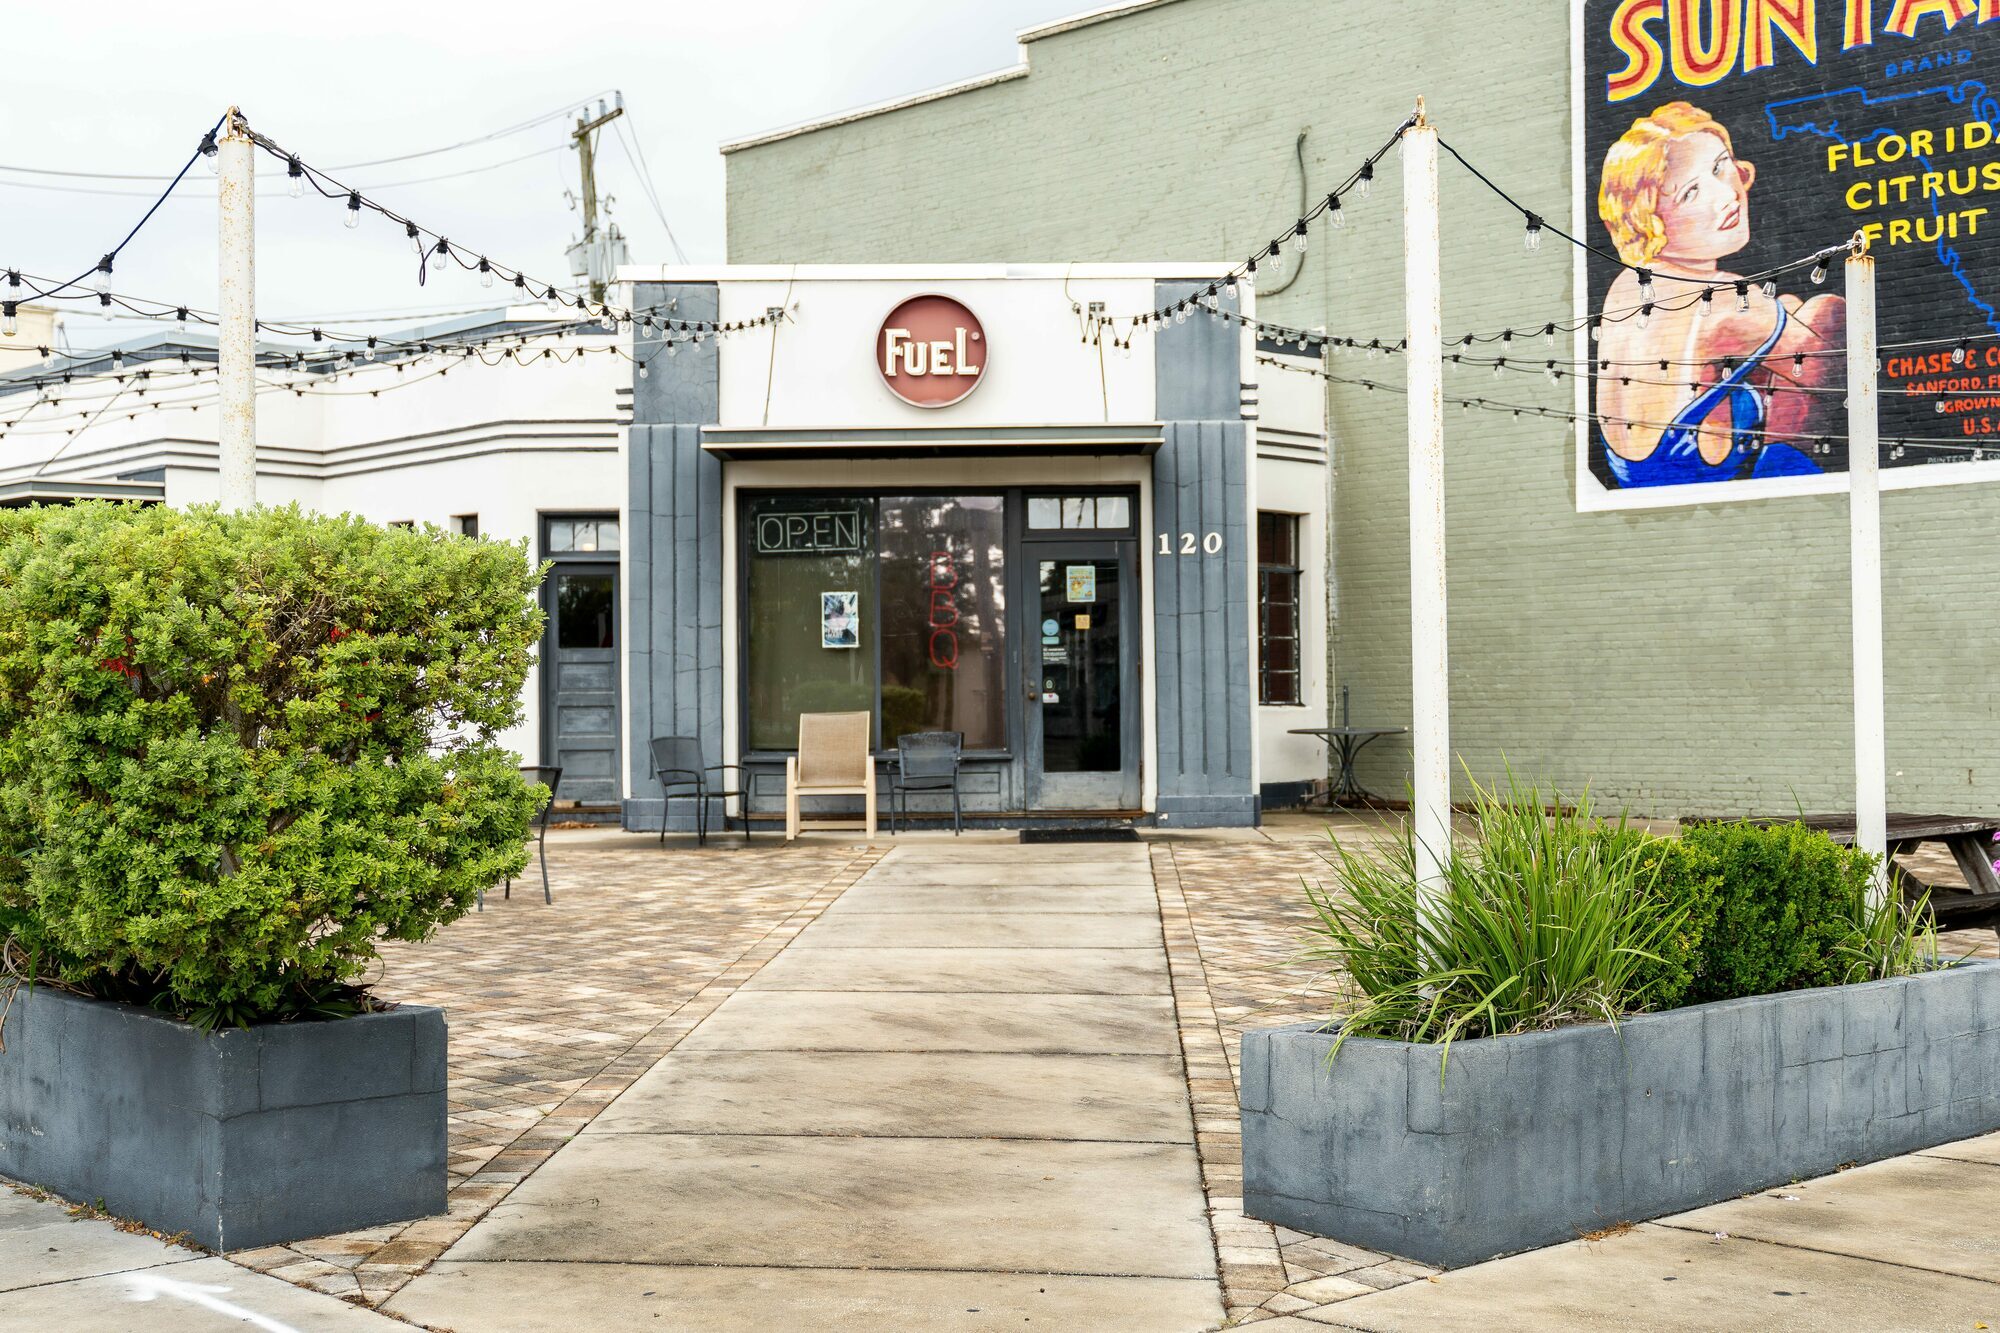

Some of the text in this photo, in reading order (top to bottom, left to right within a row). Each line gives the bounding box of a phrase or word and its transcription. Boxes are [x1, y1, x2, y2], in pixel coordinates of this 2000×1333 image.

[1885, 50, 1972, 78] BRAND
[1827, 121, 2000, 172] FLORID
[1845, 162, 2000, 210] CITRUS
[1862, 208, 1988, 251] FRUIT
[885, 327, 979, 376] FUEL
[1887, 352, 1953, 378] CHASE
[1985, 346, 2000, 367] C
[1988, 374, 2000, 388] F
[1943, 397, 2000, 414] GROWN
[1963, 417, 2000, 435] U.S.
[761, 515, 857, 550] OPEN
[1158, 532, 1223, 555] 120
[930, 551, 958, 669] BBQ
